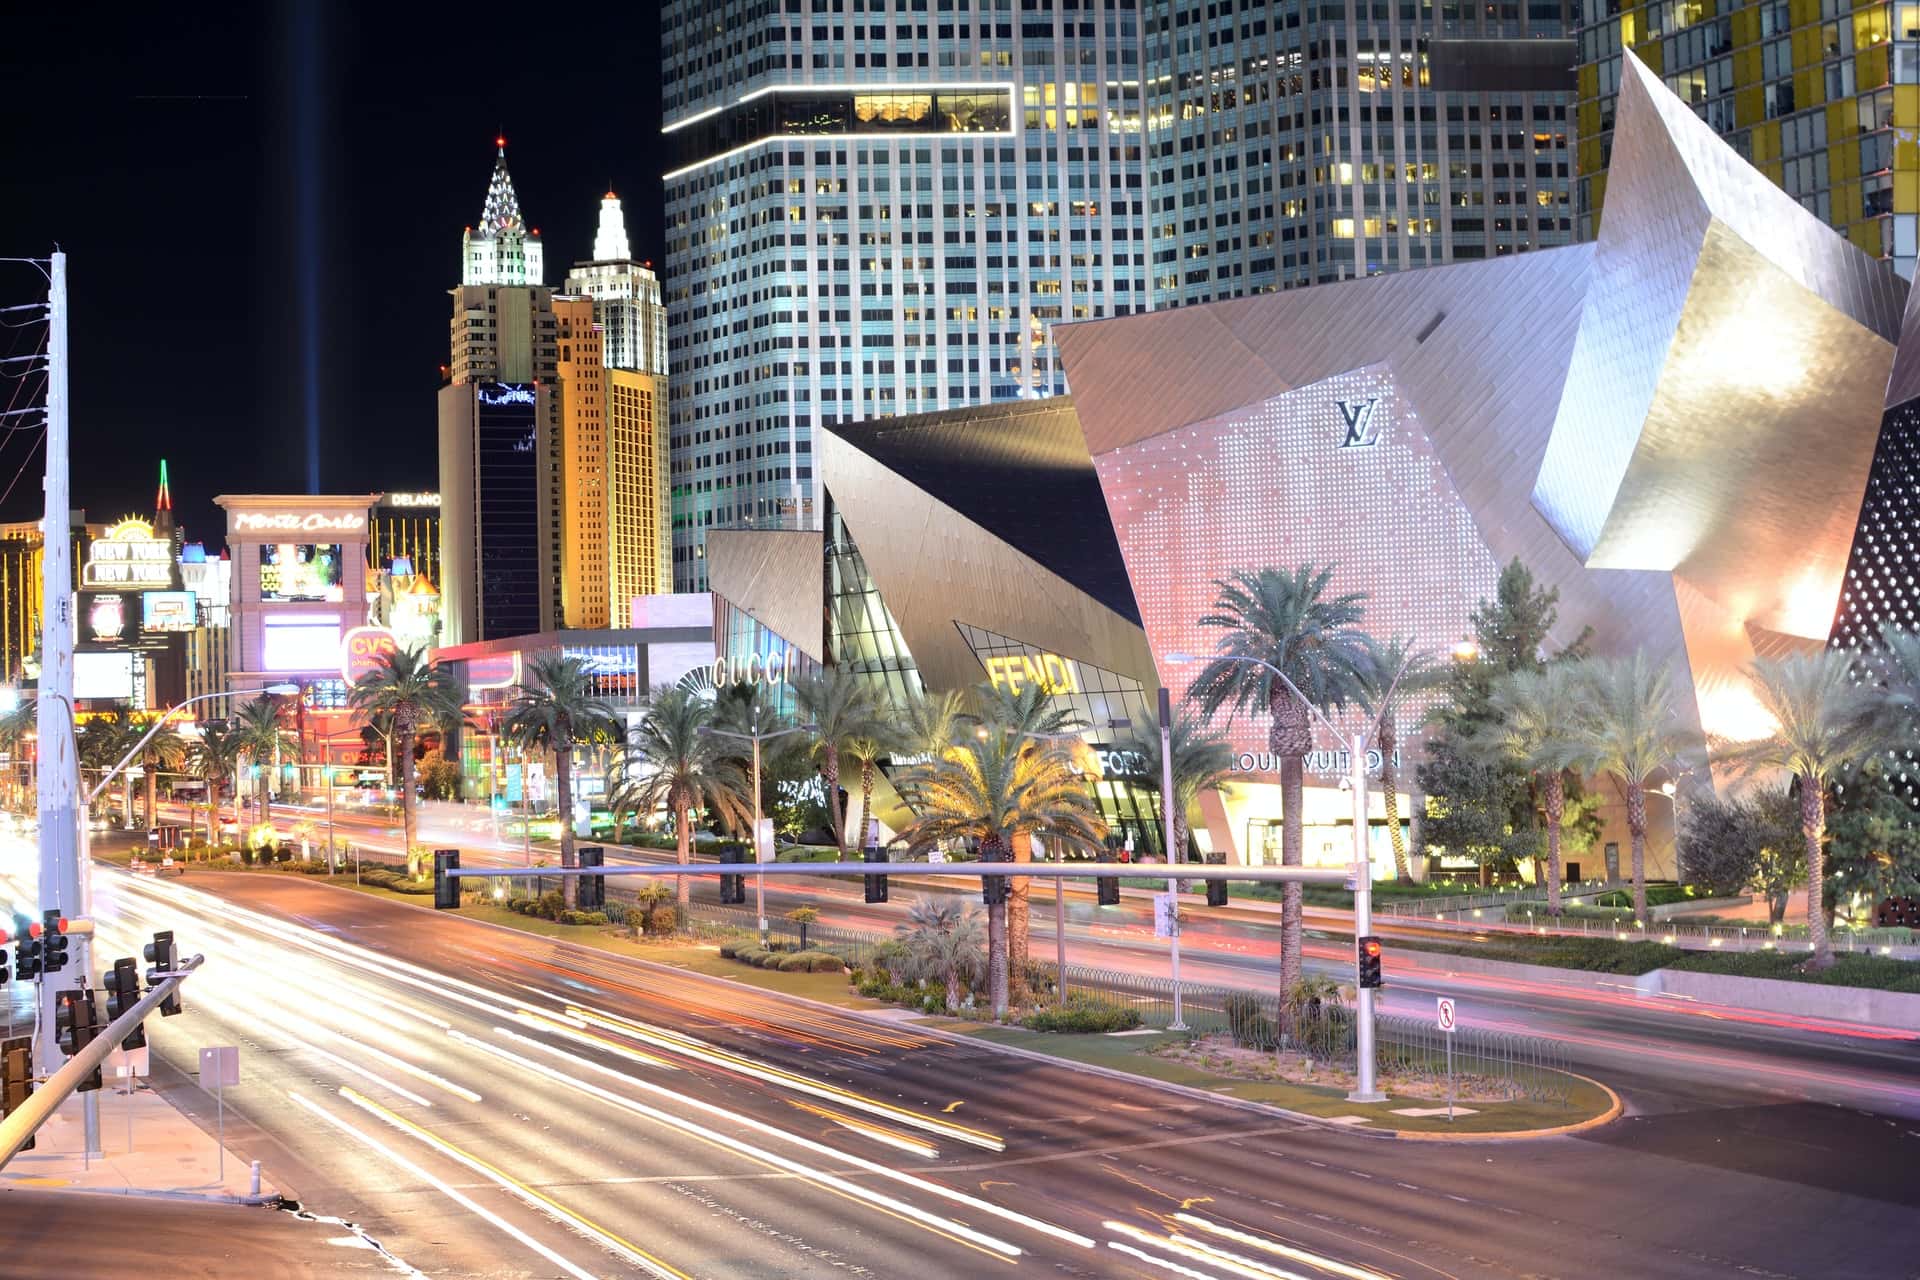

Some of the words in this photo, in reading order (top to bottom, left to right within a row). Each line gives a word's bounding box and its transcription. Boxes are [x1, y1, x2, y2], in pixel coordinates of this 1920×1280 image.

[1334, 398, 1379, 448] LV
[392, 494, 441, 506] DELANO
[234, 513, 302, 530] Monte
[303, 513, 364, 531] Carlo
[94, 541, 128, 560] NEW
[132, 541, 171, 560] YORK
[94, 563, 128, 581] NEW
[132, 563, 171, 581] YORK
[351, 637, 393, 656] CVS
[713, 648, 794, 689] GUCCI
[985, 654, 1080, 697] FENDI
[1230, 751, 1279, 771] LOUI
[1302, 749, 1399, 770] VUITON
